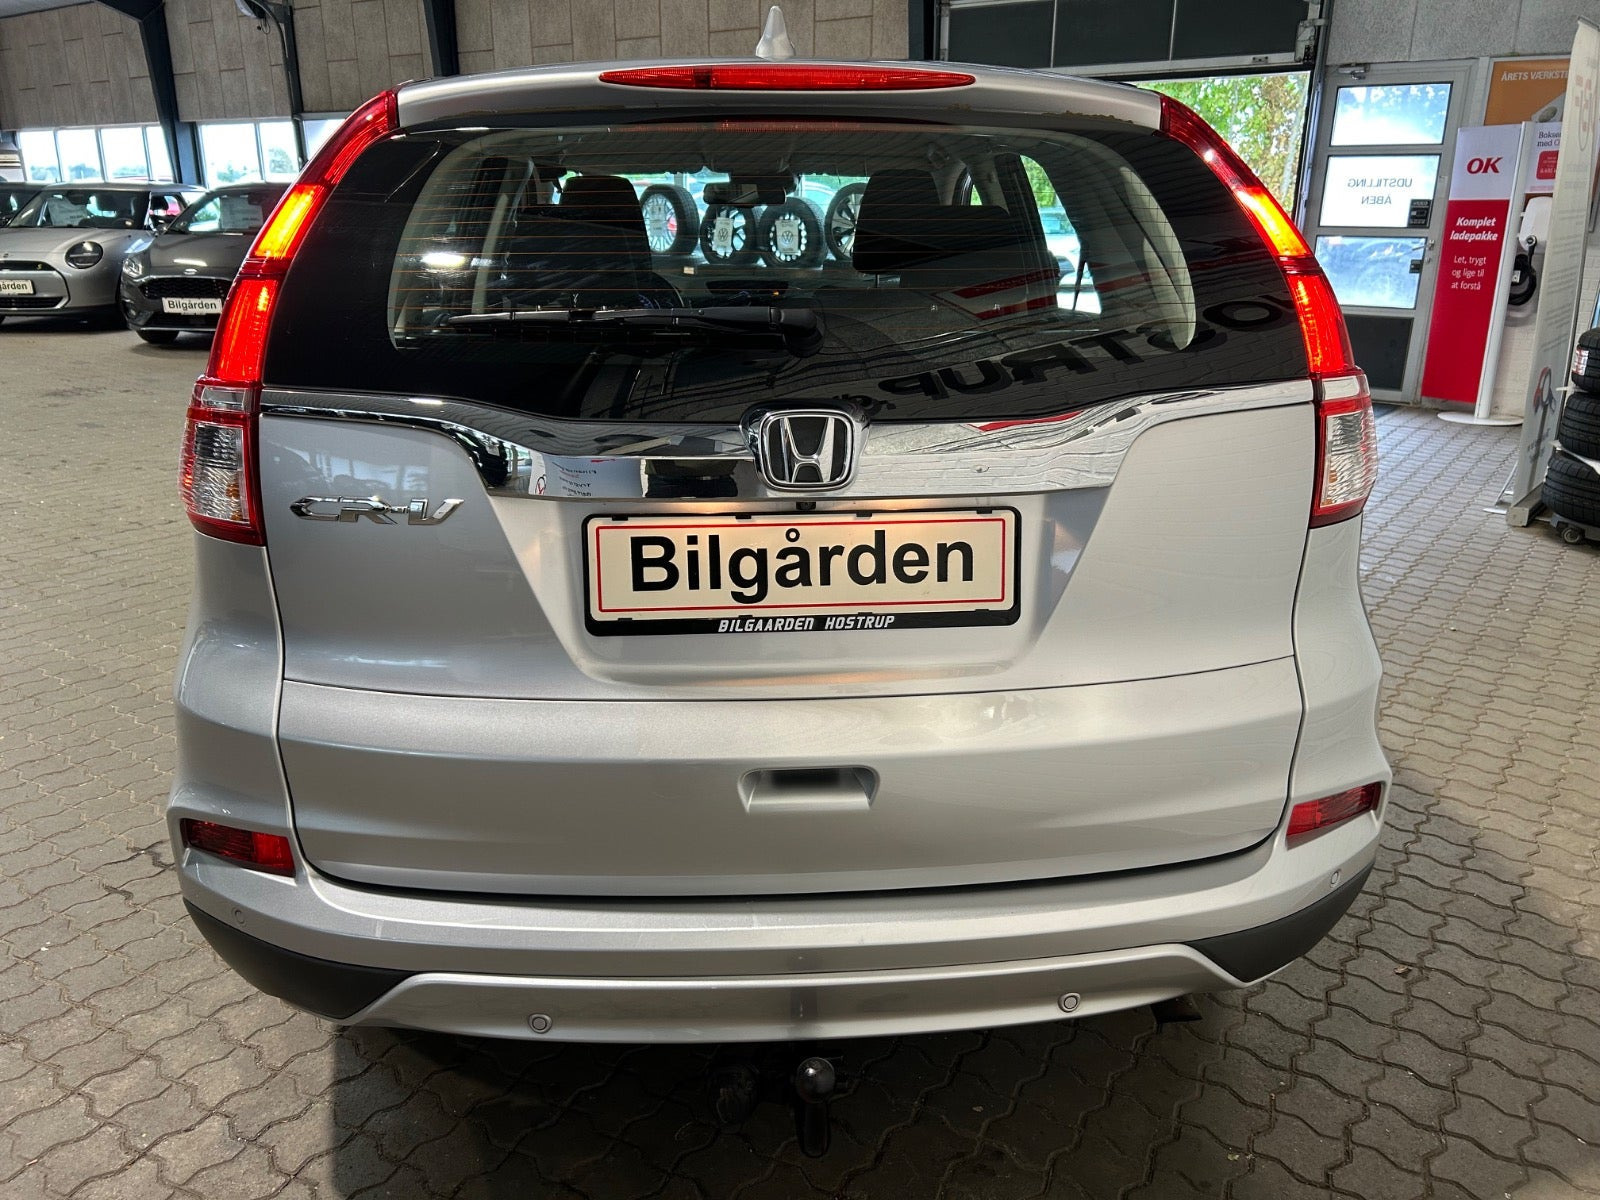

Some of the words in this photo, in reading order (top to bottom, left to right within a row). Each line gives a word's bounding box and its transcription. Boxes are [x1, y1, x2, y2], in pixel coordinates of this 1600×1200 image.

[1501, 71, 1529, 82] ÅRETS
[1537, 139, 1553, 147] med
[1467, 157, 1503, 175] OK
[1456, 217, 1496, 228] Komplet
[1450, 231, 1498, 243] ladepakke
[1454, 255, 1468, 265] Let,
[1469, 256, 1487, 267] trygt
[1462, 268, 1476, 278] lige
[1477, 268, 1485, 276] til
[1451, 281, 1459, 289] at
[1460, 280, 1481, 290] forstå
[168, 299, 218, 312] Bilgården
[289, 496, 465, 526] CR-V
[629, 527, 975, 606] Bilgården
[717, 616, 815, 634] BILGAARDEN
[825, 615, 896, 631] HOSTRUP
